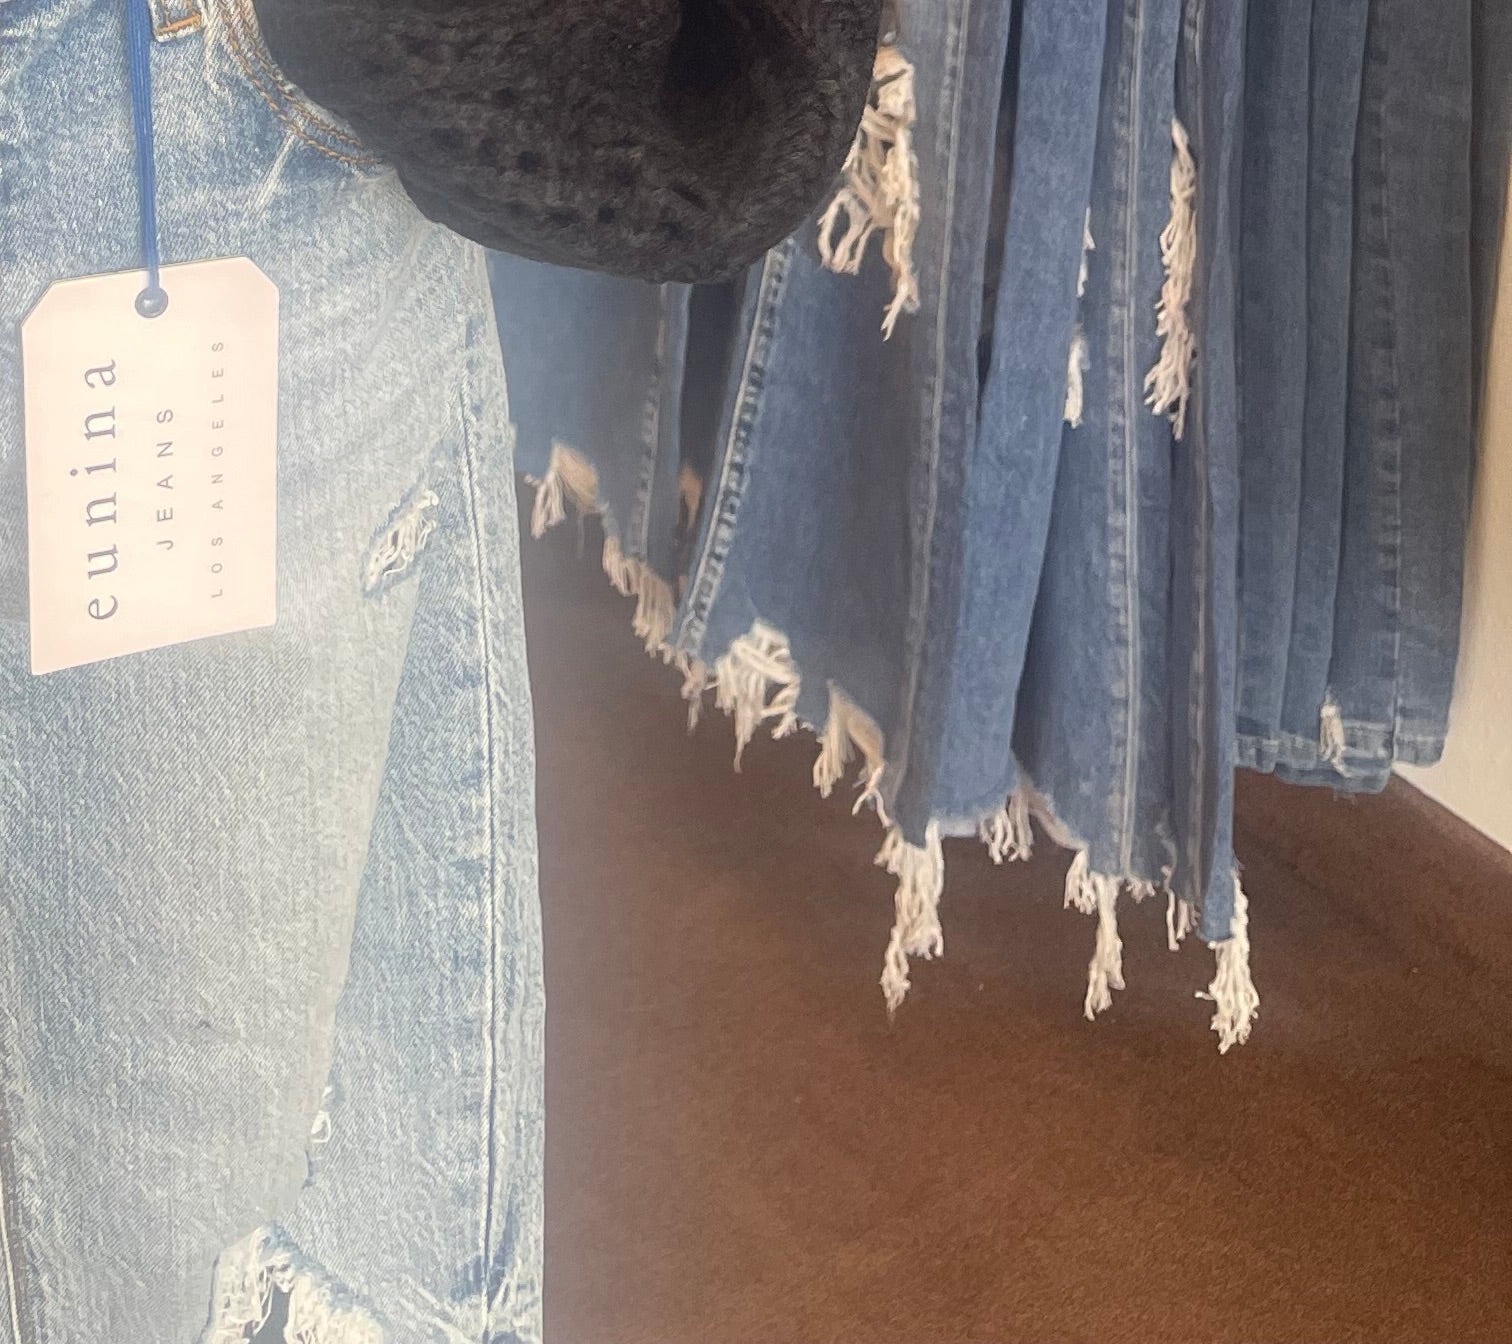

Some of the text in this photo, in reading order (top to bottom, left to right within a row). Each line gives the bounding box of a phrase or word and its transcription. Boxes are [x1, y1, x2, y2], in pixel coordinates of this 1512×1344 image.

[69, 358, 119, 620] eunina
[156, 408, 175, 551] JEANS
[210, 341, 225, 598] LOS ANGELES
